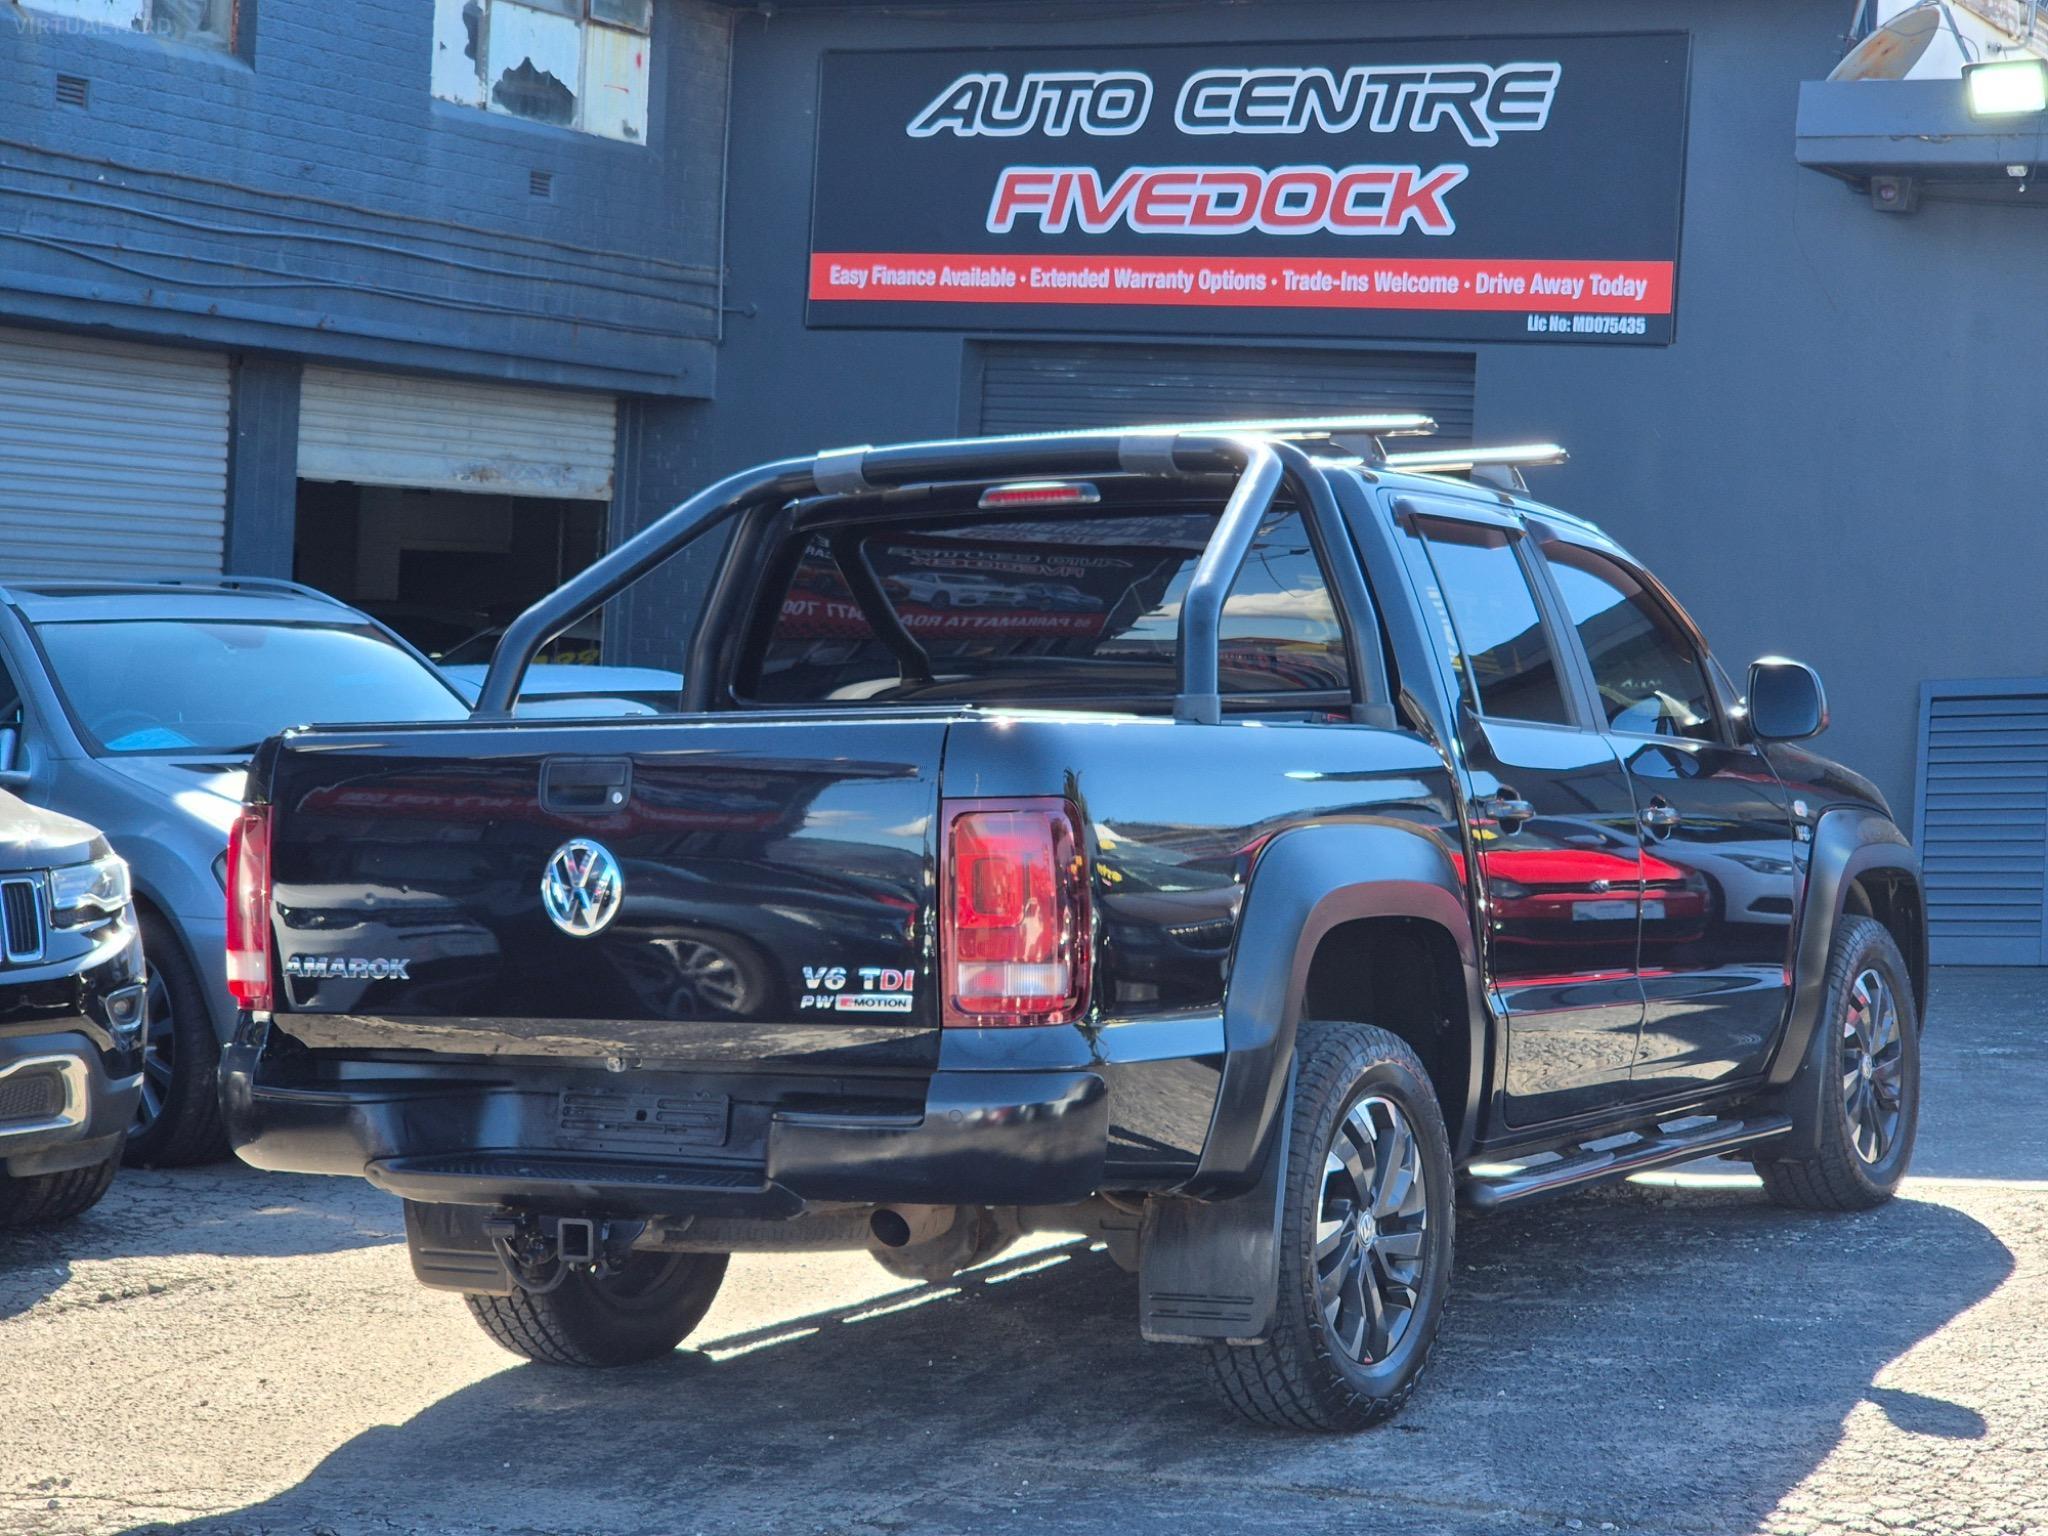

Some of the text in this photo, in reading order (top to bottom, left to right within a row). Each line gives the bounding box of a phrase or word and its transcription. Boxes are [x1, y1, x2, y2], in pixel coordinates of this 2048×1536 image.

[906, 62, 1562, 147] AUTO CENTRE
[986, 164, 1470, 236] FIVEDOCK
[830, 265, 1648, 301] Easy Finance Available Extended Warranty Options Trade-Ins Welcome Drive Away Today
[1527, 314, 1646, 335] Lic No: MD075435
[283, 956, 410, 980] AMAROK
[802, 966, 915, 991] V6 TDI
